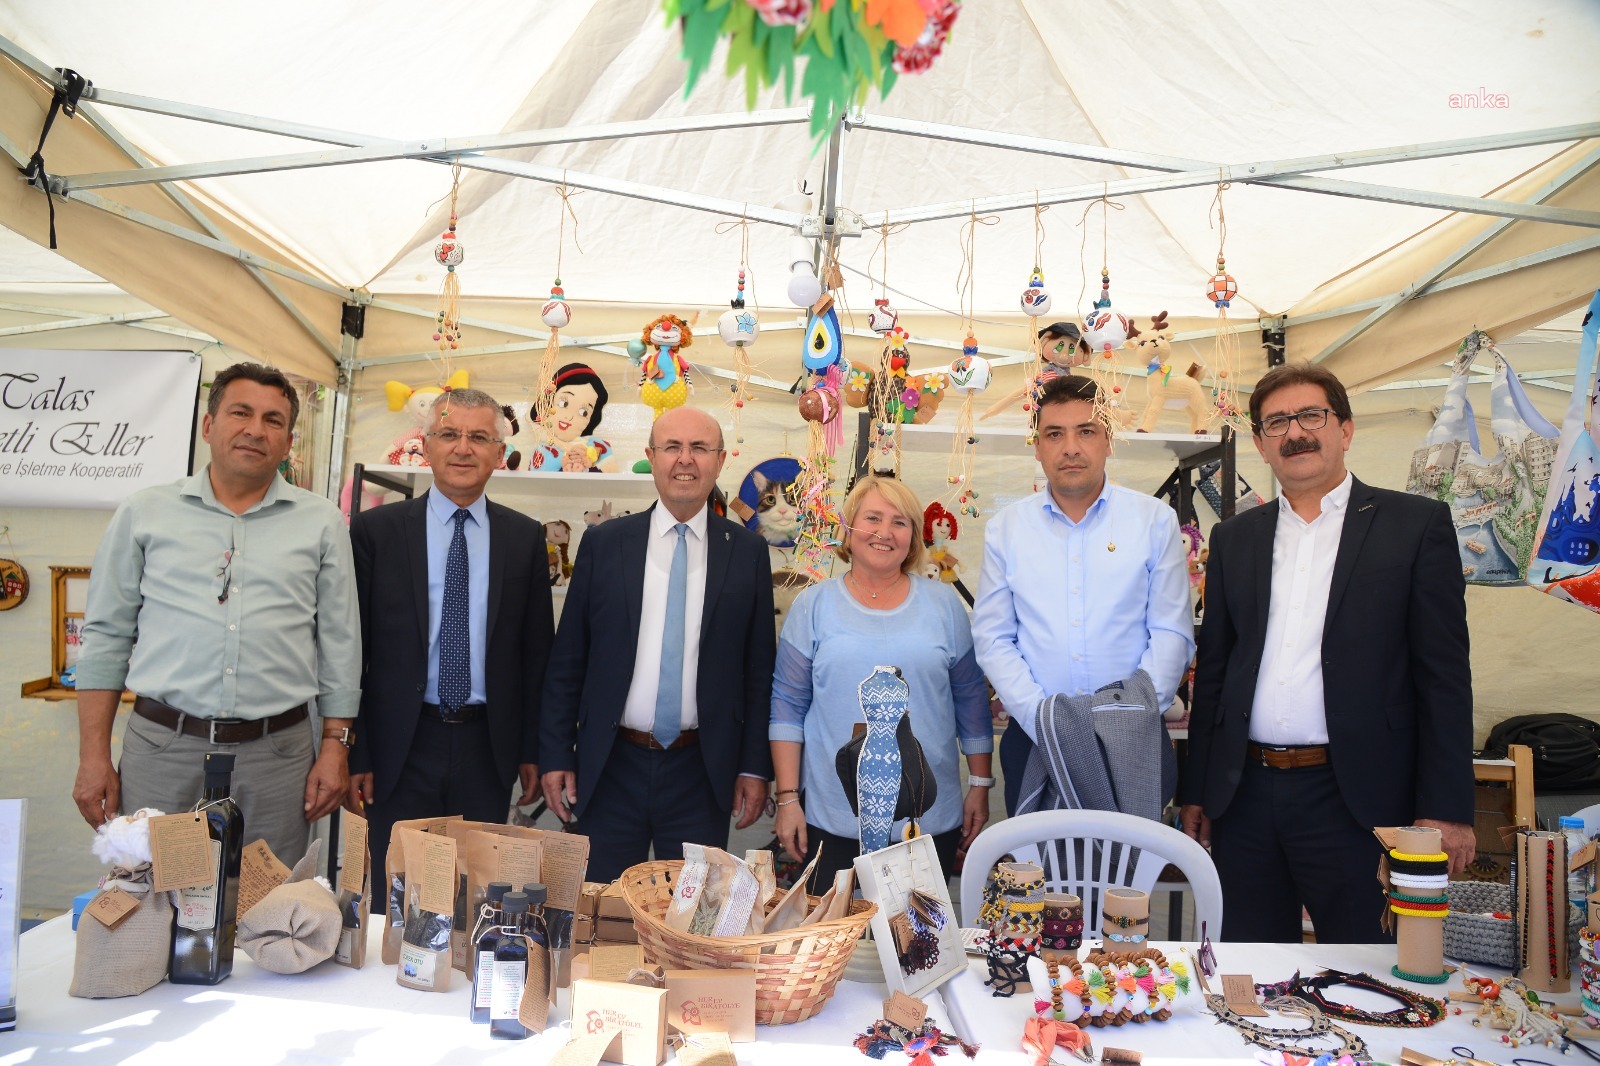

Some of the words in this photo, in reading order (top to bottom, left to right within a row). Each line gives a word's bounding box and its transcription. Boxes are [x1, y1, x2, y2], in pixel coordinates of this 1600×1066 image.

[0, 372, 96, 412] Talas
[50, 421, 154, 457] Eller
[15, 457, 66, 478] İşletme
[70, 461, 144, 481] Kooperatifi
